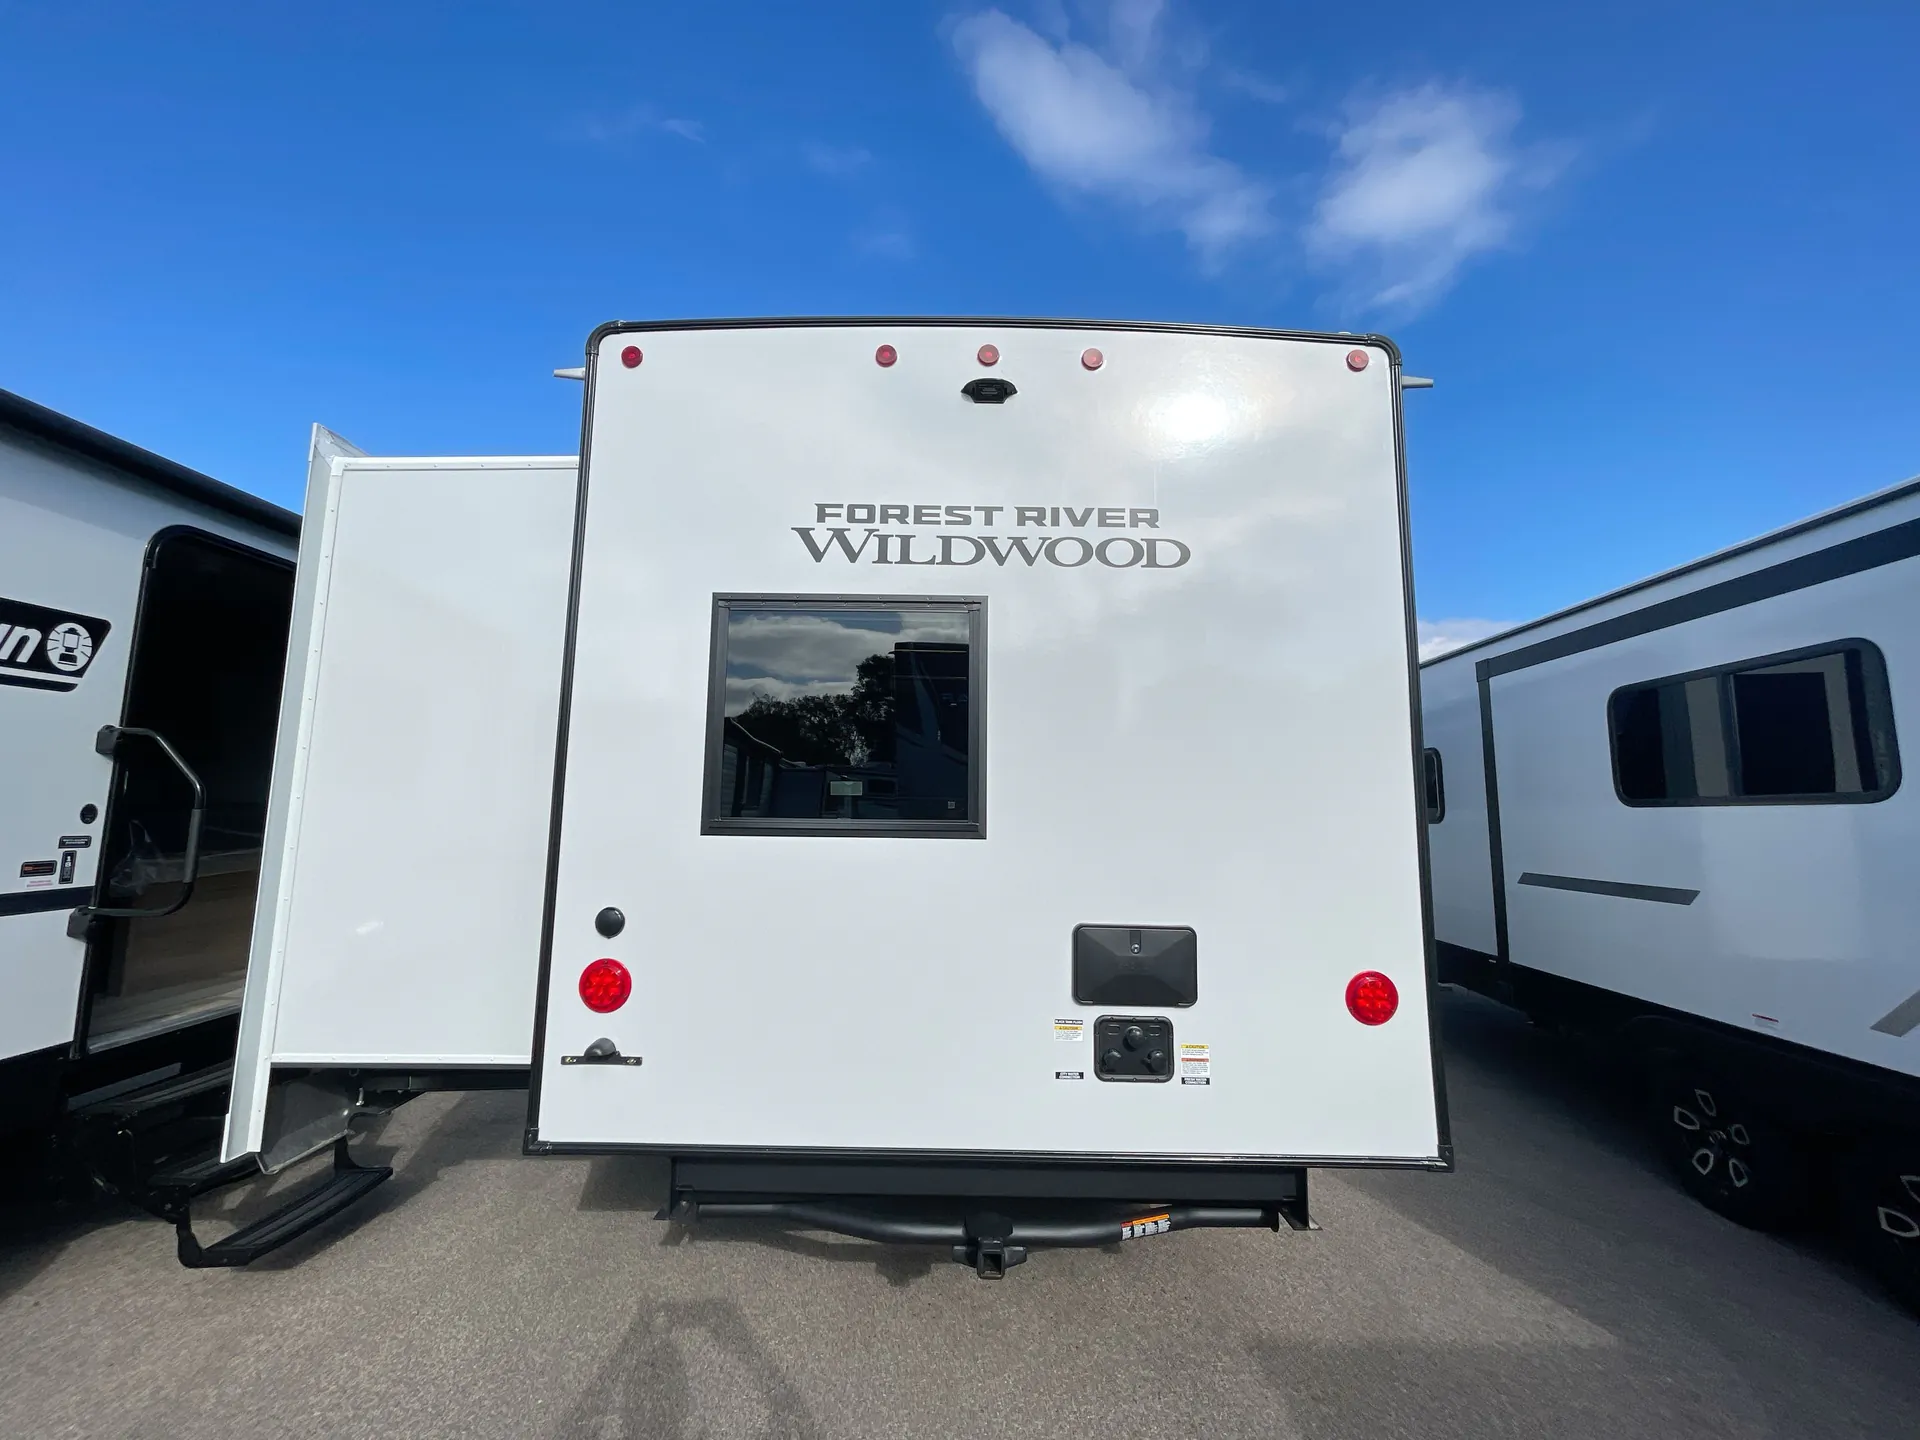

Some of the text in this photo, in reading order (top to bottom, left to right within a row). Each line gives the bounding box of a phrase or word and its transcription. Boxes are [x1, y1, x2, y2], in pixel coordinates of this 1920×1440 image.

[814, 503, 1160, 529] FOREST RIVER
[790, 527, 1191, 569] WILDWOOD
